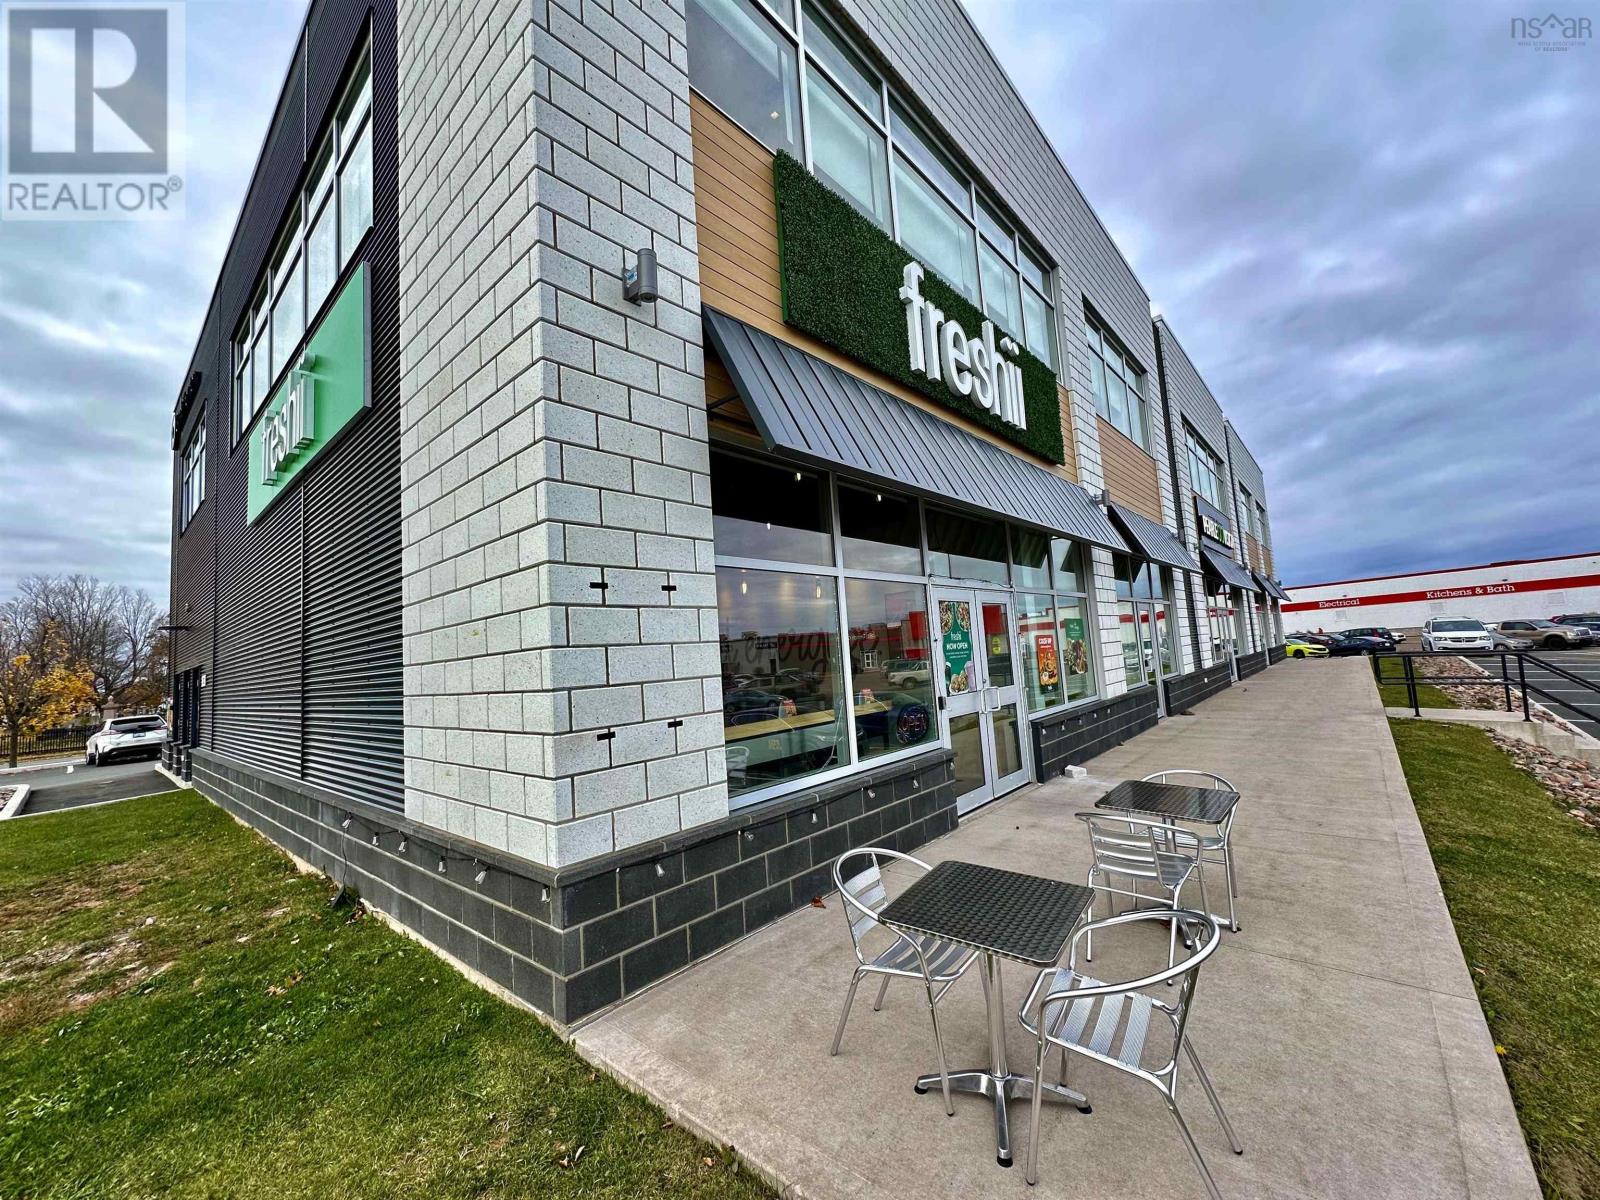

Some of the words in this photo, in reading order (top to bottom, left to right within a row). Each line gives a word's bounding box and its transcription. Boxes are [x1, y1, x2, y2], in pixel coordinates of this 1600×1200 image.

[898, 261, 1027, 431] freshii
[1426, 589, 1472, 599] Kitchens
[1475, 586, 1484, 594] &
[1486, 584, 1515, 593] Bath
[1319, 598, 1360, 608] Electrical
[946, 642, 957, 651] NOW
[957, 641, 968, 650] OPEN
